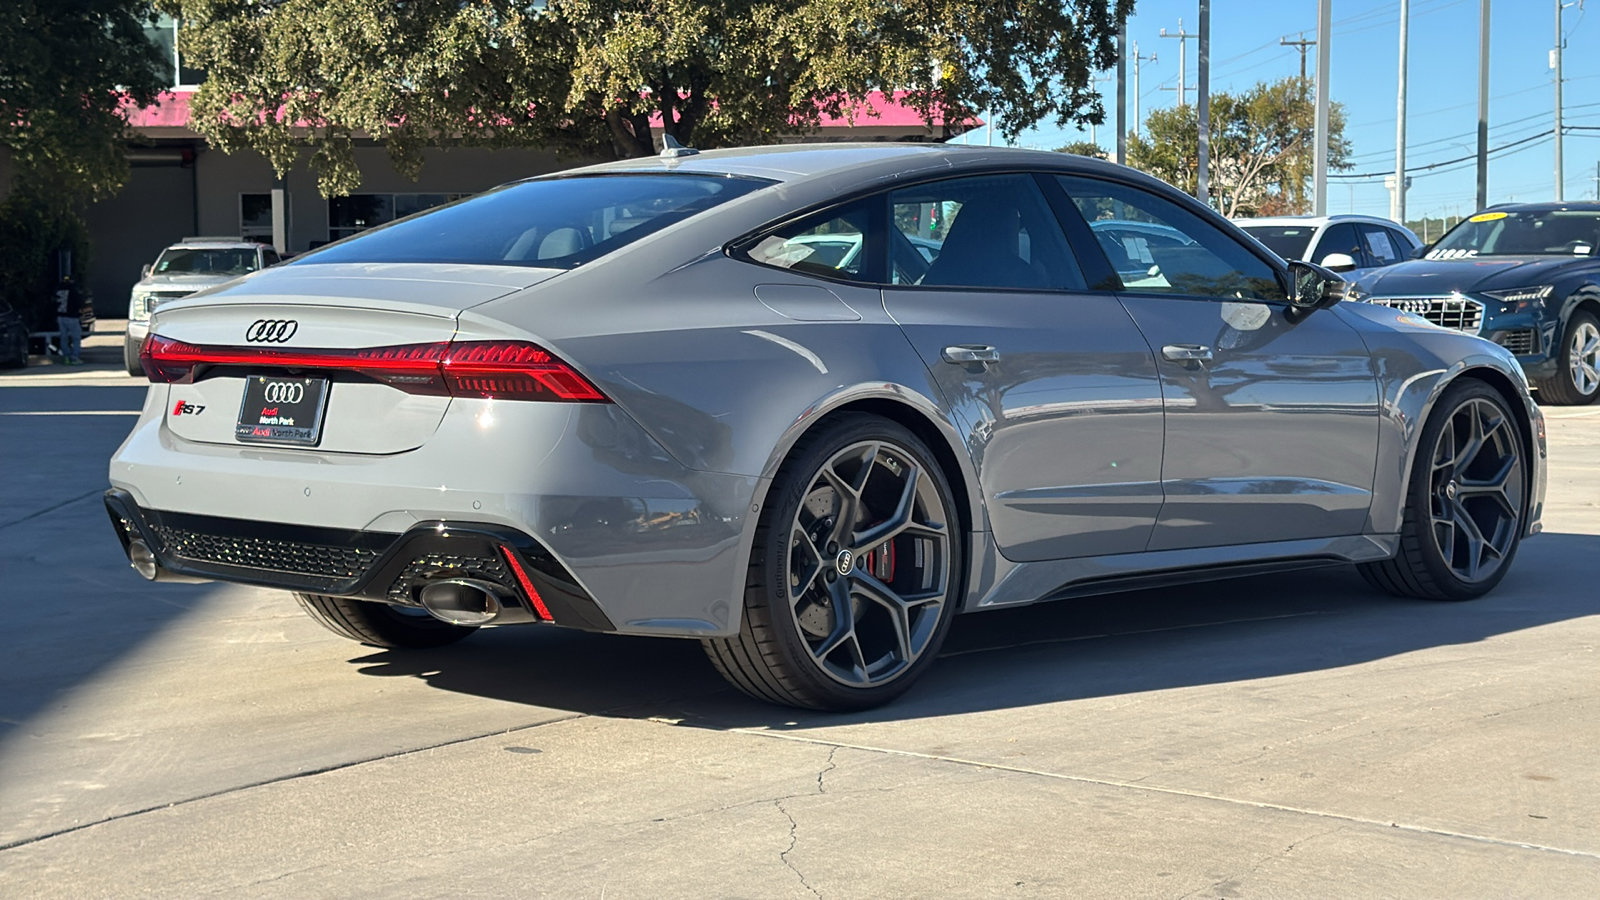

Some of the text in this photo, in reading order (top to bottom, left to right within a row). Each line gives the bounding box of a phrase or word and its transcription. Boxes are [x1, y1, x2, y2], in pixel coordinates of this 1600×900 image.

[261, 407, 278, 415] Audi
[259, 416, 294, 425] North Park
[252, 428, 270, 436] Audi
[272, 429, 293, 437] North
[295, 430, 312, 438] Park
